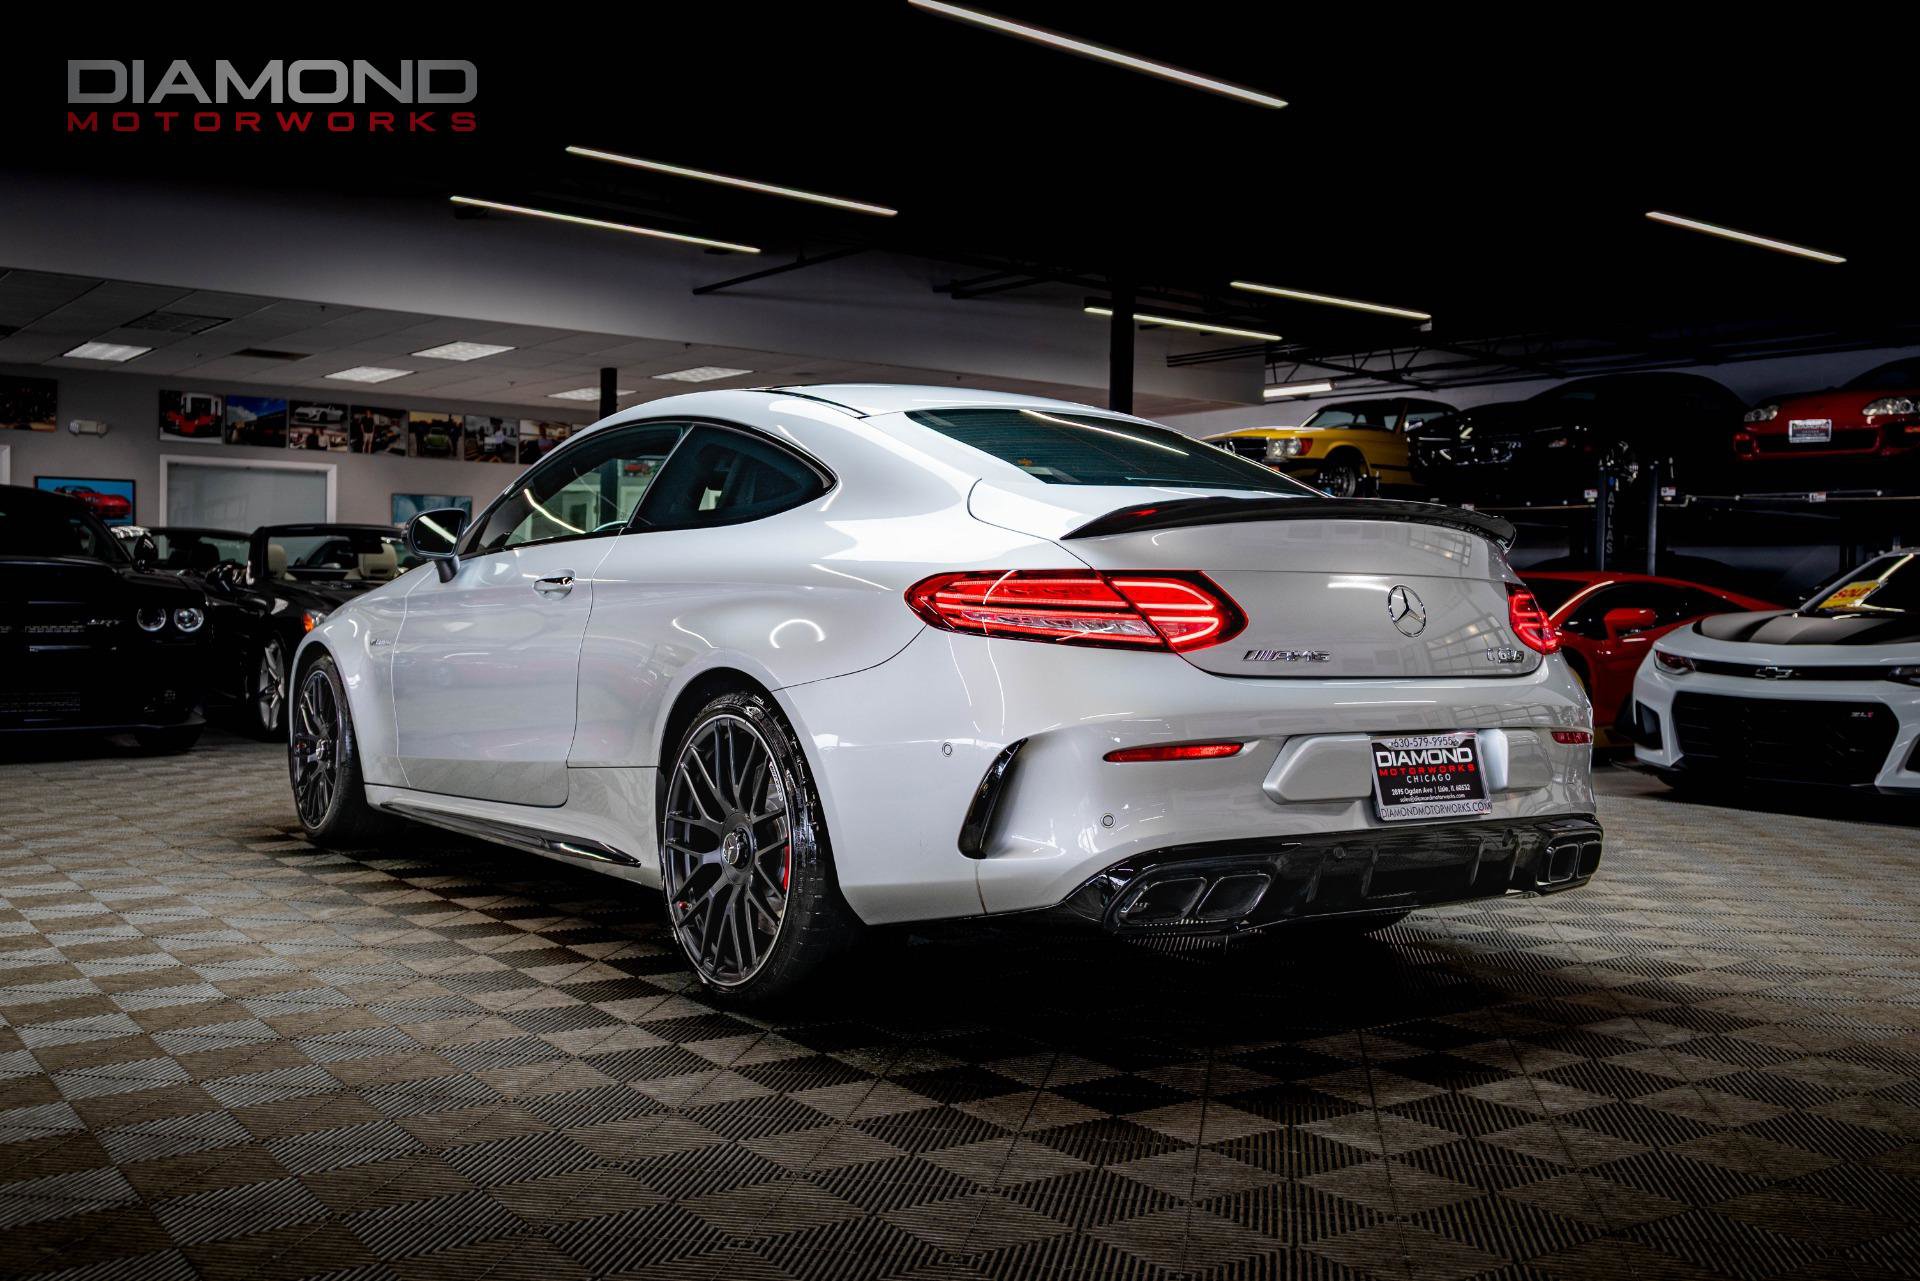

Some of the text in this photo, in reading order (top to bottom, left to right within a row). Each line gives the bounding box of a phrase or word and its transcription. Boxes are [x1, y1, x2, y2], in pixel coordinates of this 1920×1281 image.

[1606, 491, 1615, 553] ATLAS
[1393, 736, 1453, 748] 630-579-9955
[1375, 747, 1473, 767] DIAMOND
[1379, 763, 1475, 777] MOTORWORKS
[1406, 773, 1452, 784] CHICAGO
[1404, 787, 1423, 796] Ogden
[1423, 786, 1433, 794] Ave
